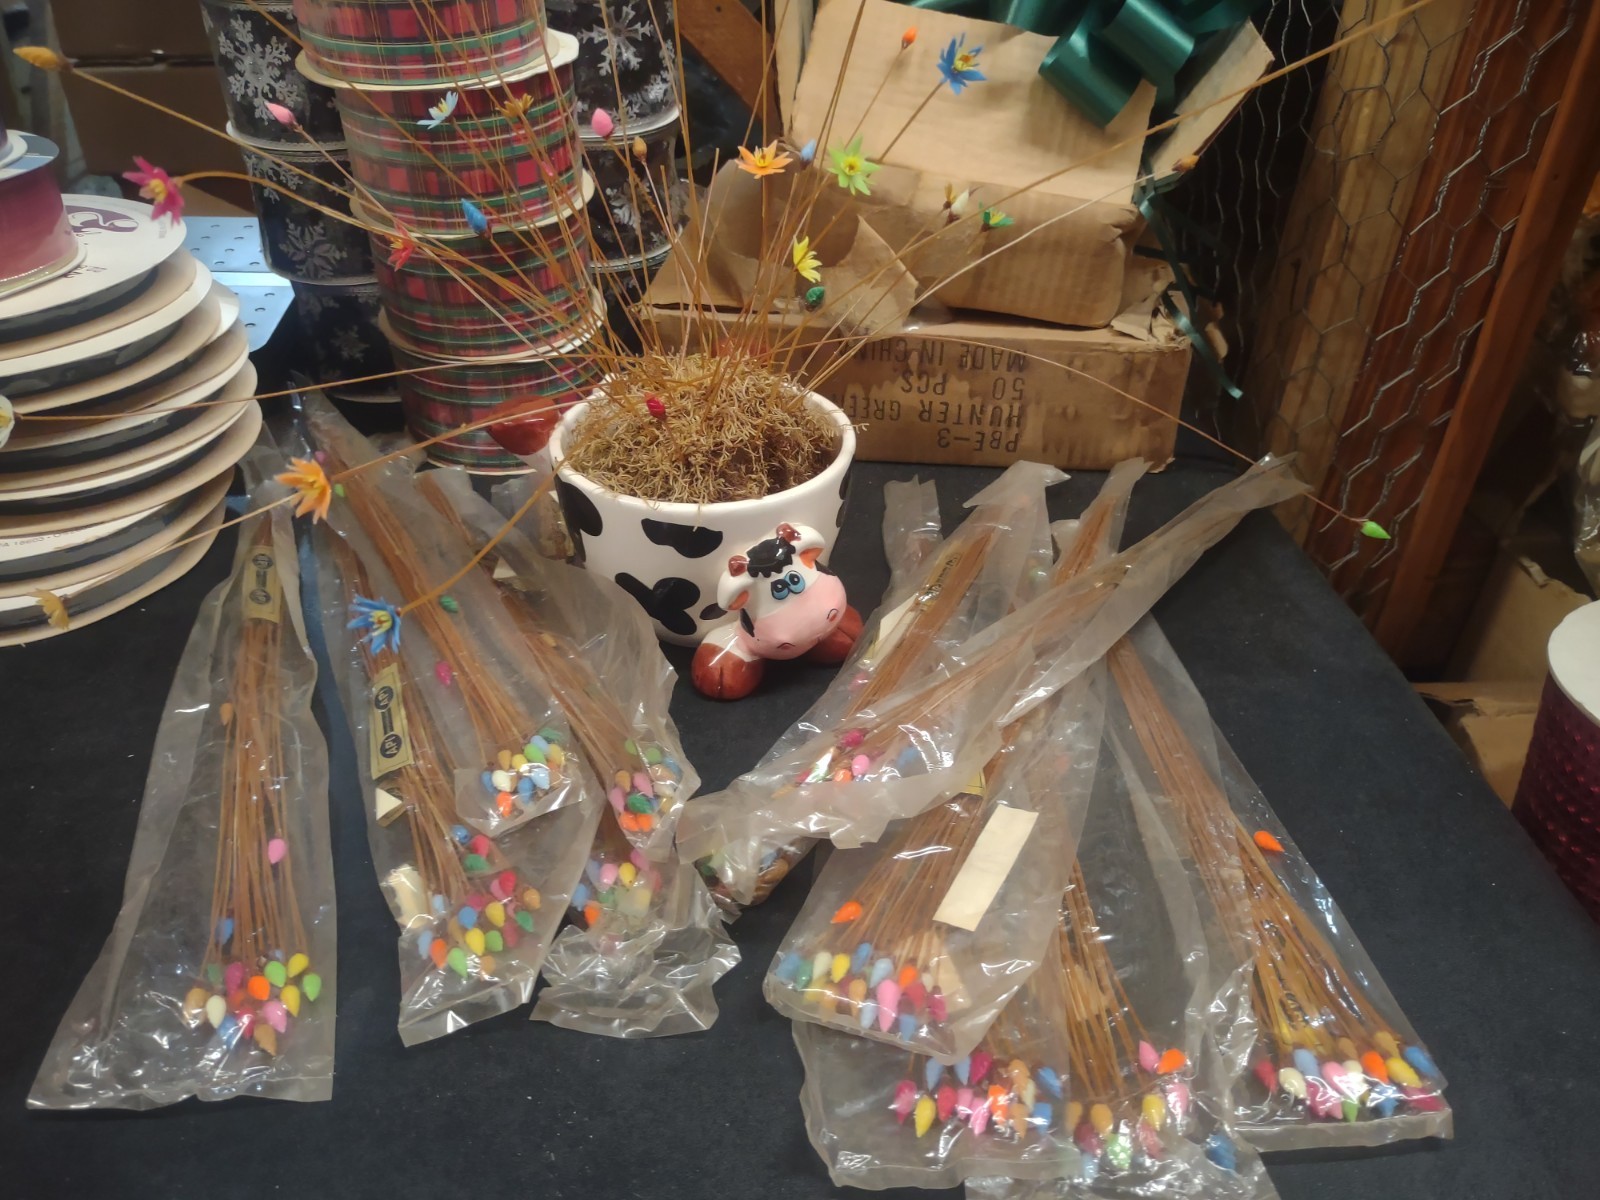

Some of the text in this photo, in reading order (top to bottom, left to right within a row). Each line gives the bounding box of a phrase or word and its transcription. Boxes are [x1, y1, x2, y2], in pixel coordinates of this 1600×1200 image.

[918, 340, 945, 366] IN
[957, 342, 1028, 372] MADE
[991, 377, 1025, 401] 50
[918, 400, 1022, 428] HUNTER
[937, 428, 1020, 452] PBE-3
